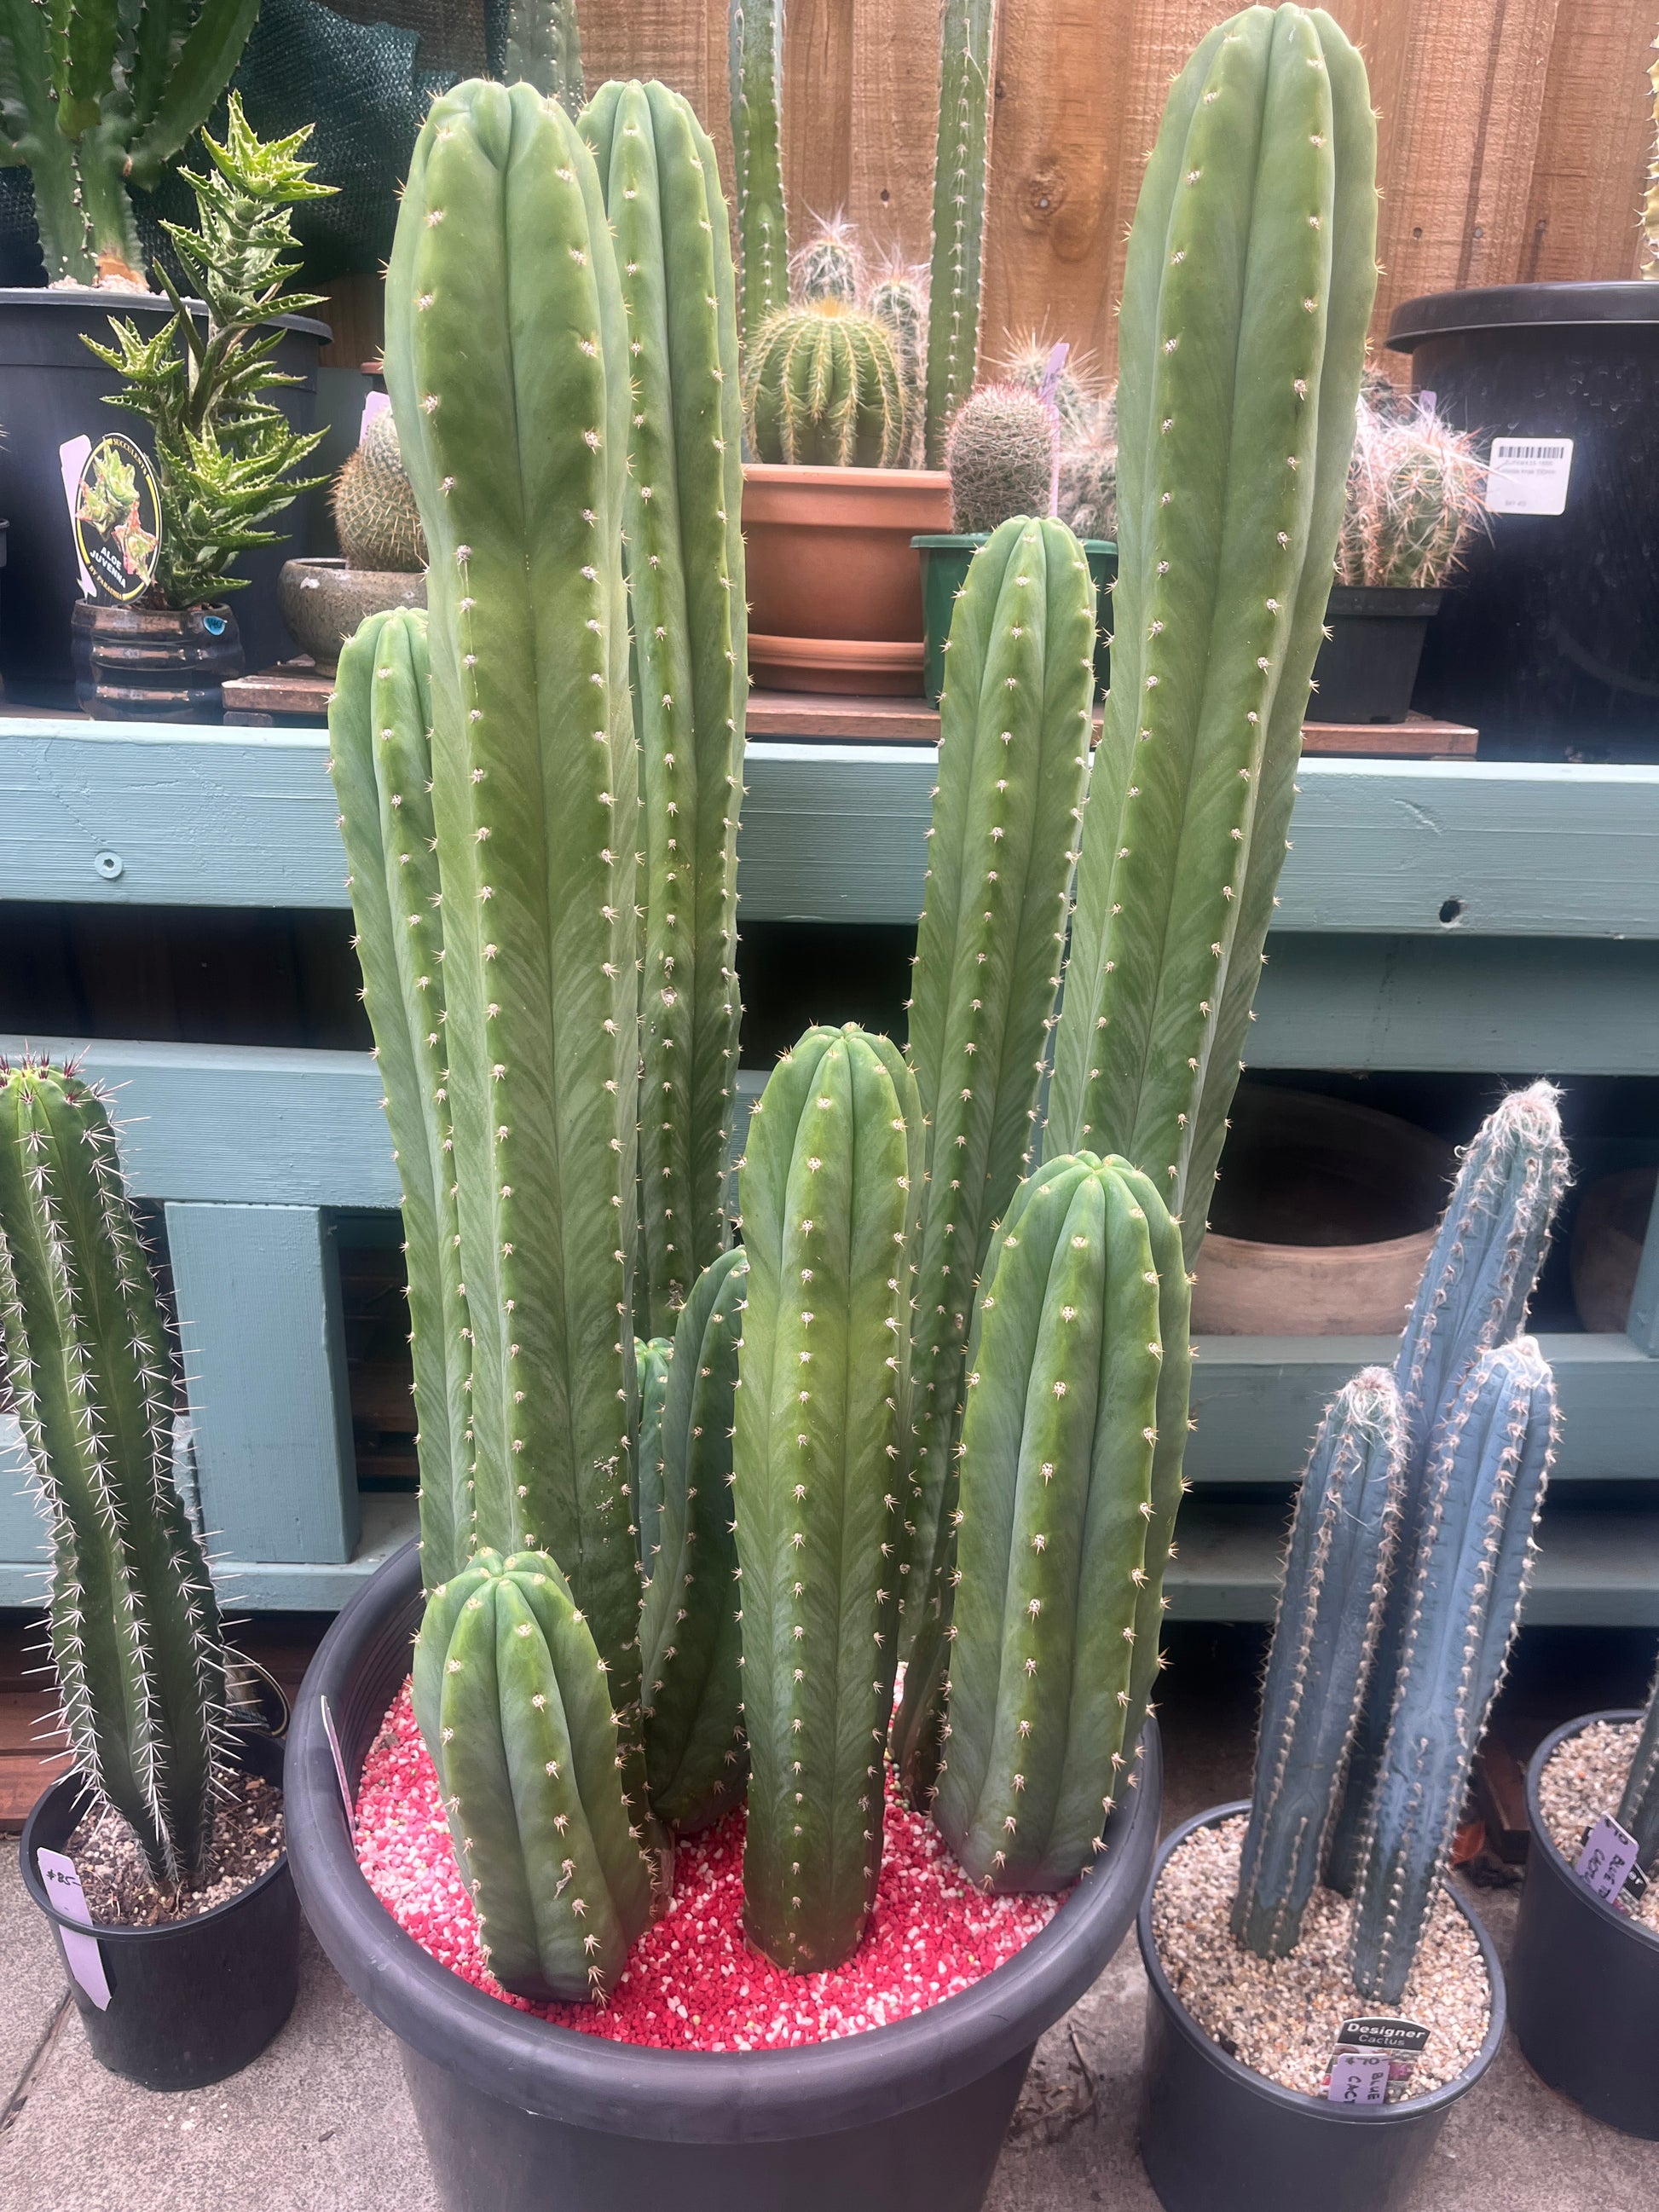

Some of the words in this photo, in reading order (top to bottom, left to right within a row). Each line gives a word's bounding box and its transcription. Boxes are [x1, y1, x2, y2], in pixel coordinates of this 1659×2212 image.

[113, 438, 148, 476] SUCCULENTS
[90, 550, 126, 588] JUVENNA
[101, 546, 122, 570] ALOE
[1346, 2023, 1425, 2039] Designer
[1358, 2034, 1405, 2046] Cactus
[1367, 2071, 1384, 2100] BLUE
